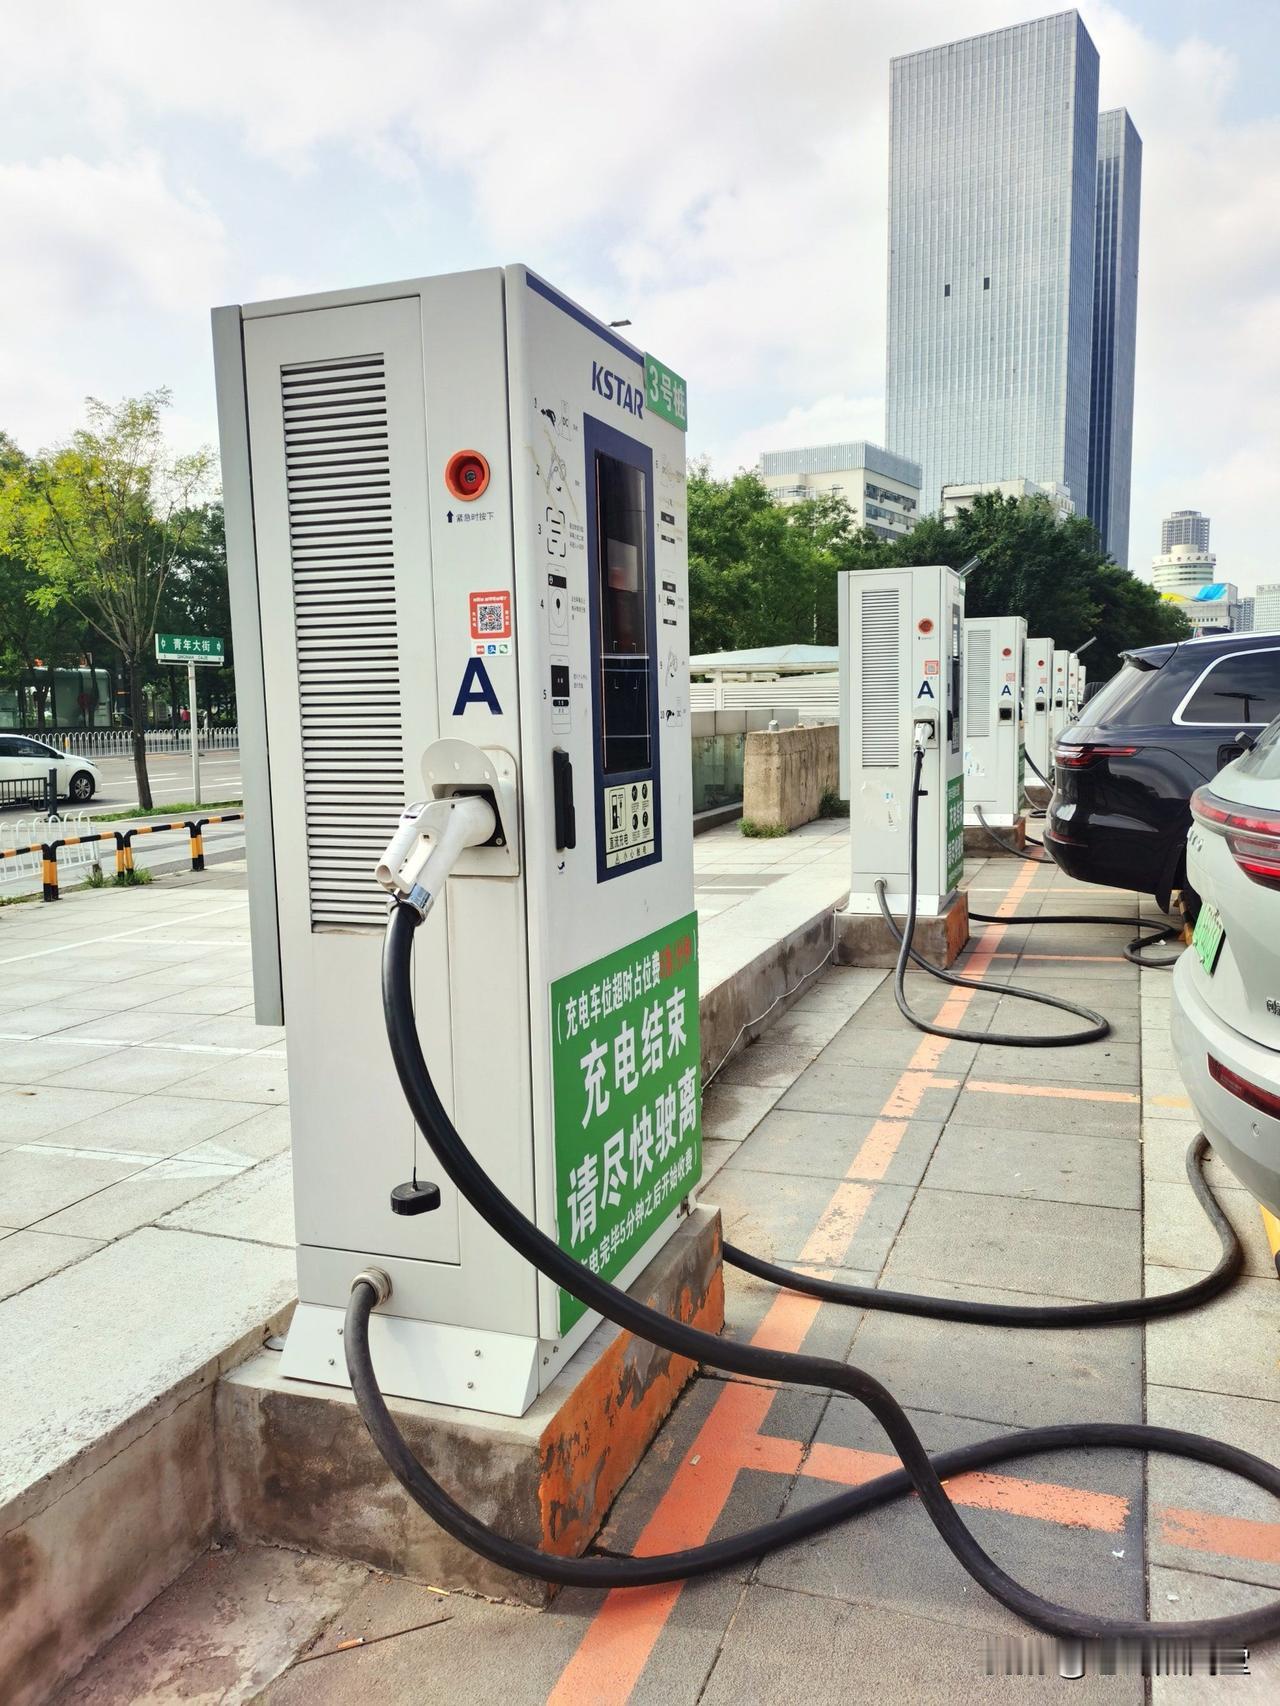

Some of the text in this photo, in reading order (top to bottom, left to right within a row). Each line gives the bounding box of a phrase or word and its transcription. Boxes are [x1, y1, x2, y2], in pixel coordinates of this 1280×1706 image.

[592, 361, 644, 420] KSTAR
[649, 364, 686, 421] 3号桩
[456, 511, 495, 523] 紧急时按下
[537, 523, 542, 535] 3
[173, 639, 210, 652] 青年大街
[452, 658, 503, 715] A
[543, 689, 548, 700] 5
[917, 680, 935, 699] A
[1001, 684, 1012, 696] A
[1037, 686, 1045, 695] A
[1056, 687, 1063, 695] A
[580, 986, 688, 1129] 充电结束
[567, 1064, 698, 1249] 请尽快驶离
[571, 1141, 699, 1288] 电完毕5分钟之后开始收费）
